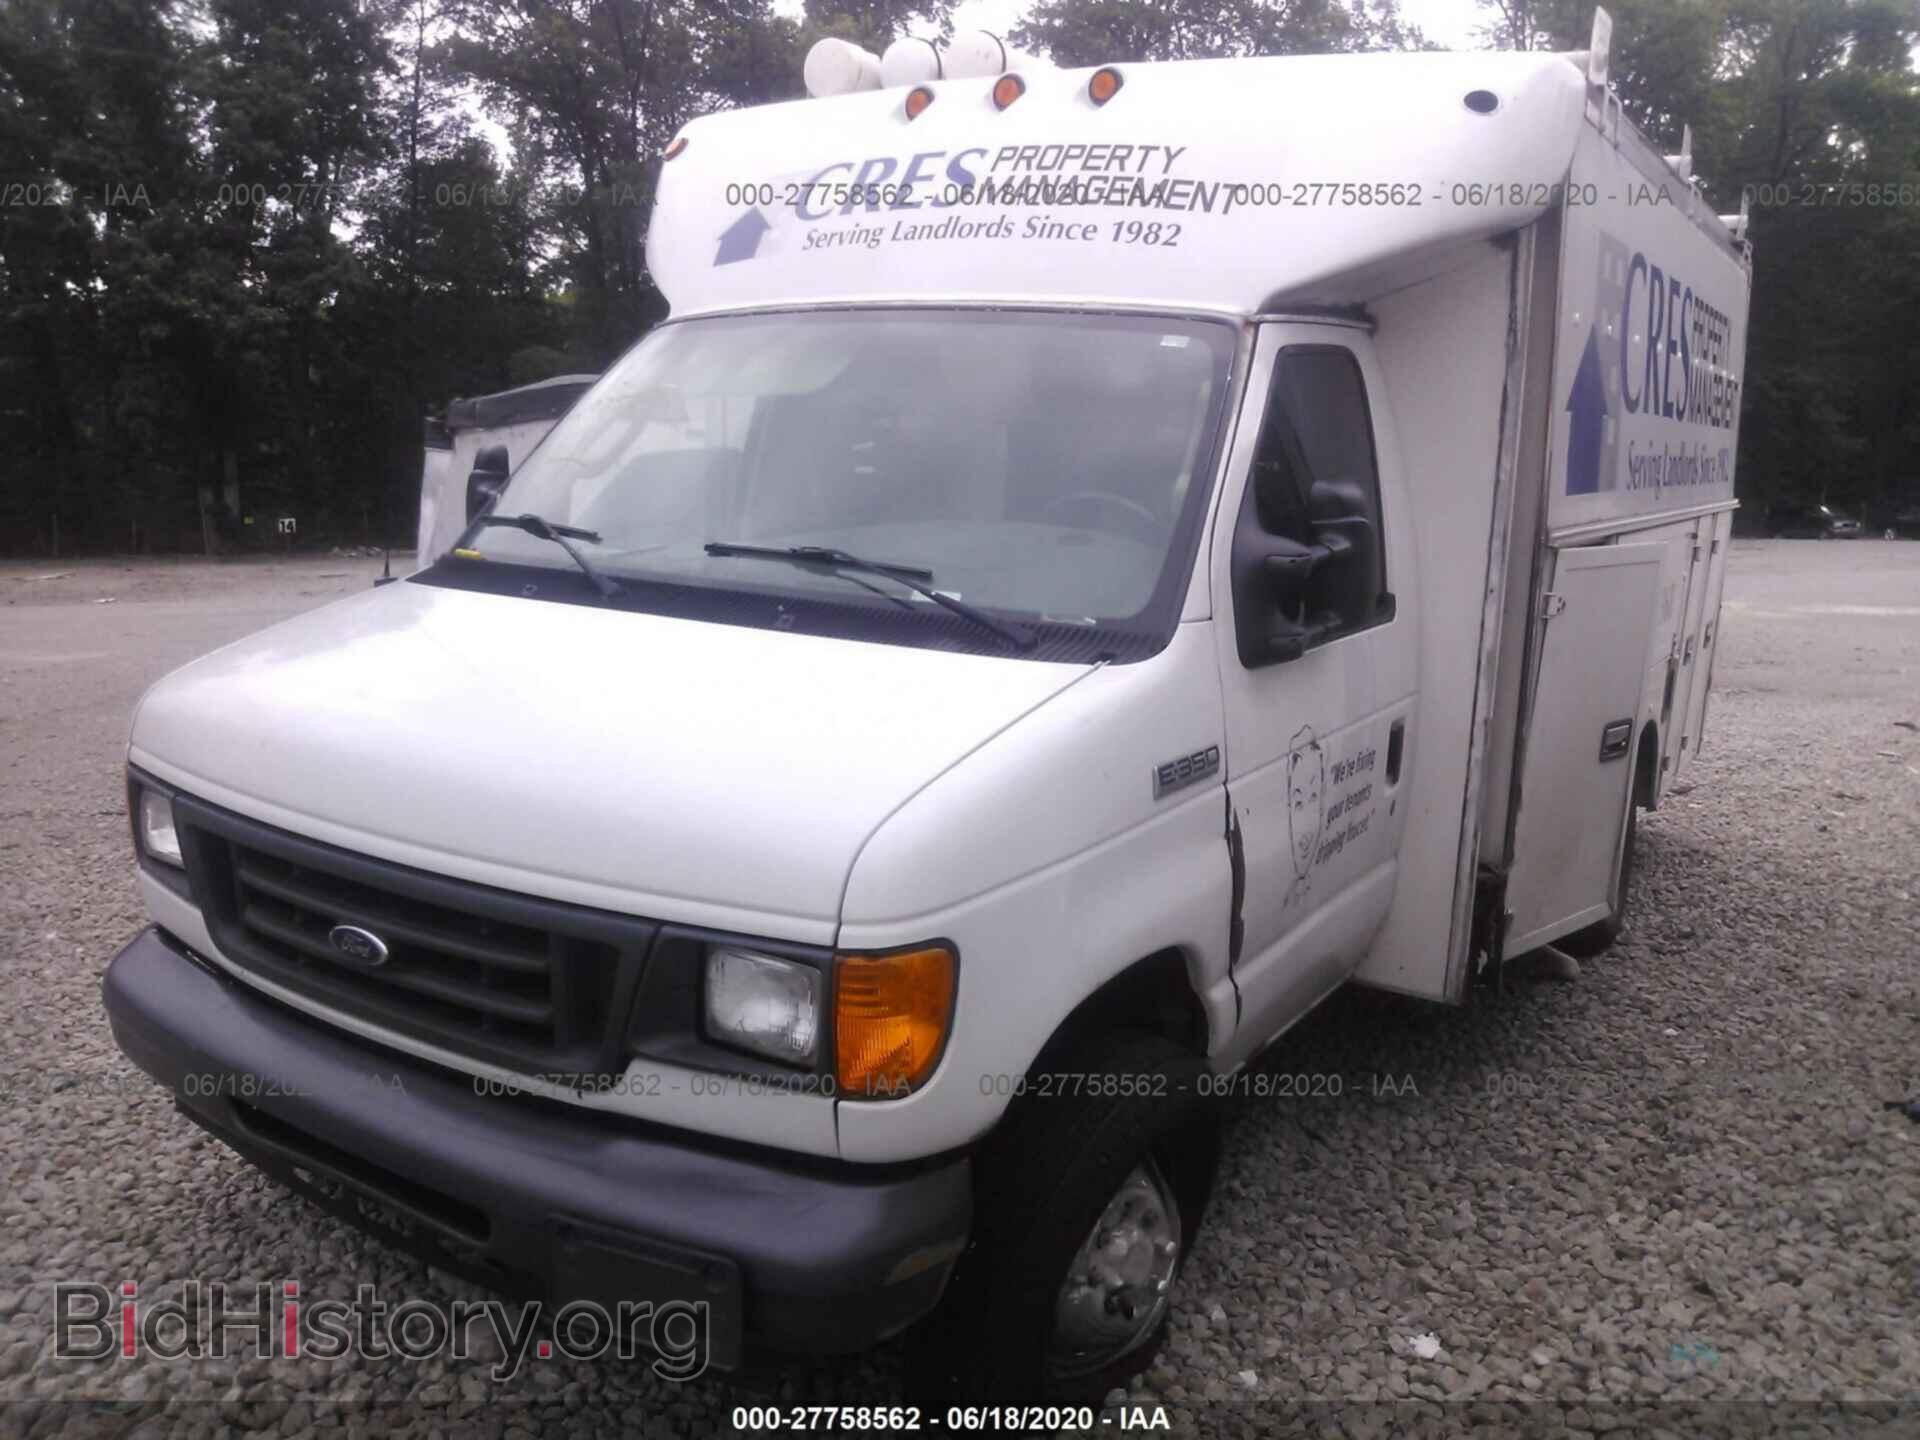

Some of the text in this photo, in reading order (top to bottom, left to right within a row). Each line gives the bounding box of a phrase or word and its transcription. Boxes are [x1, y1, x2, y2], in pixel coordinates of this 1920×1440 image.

[990, 144, 1186, 174] PROPERTY
[795, 147, 989, 221] CRES
[978, 174, 1247, 215] MANAGEMENT
[802, 214, 1182, 250] Serving Landlords Since 1982
[1620, 251, 1693, 423] CRES
